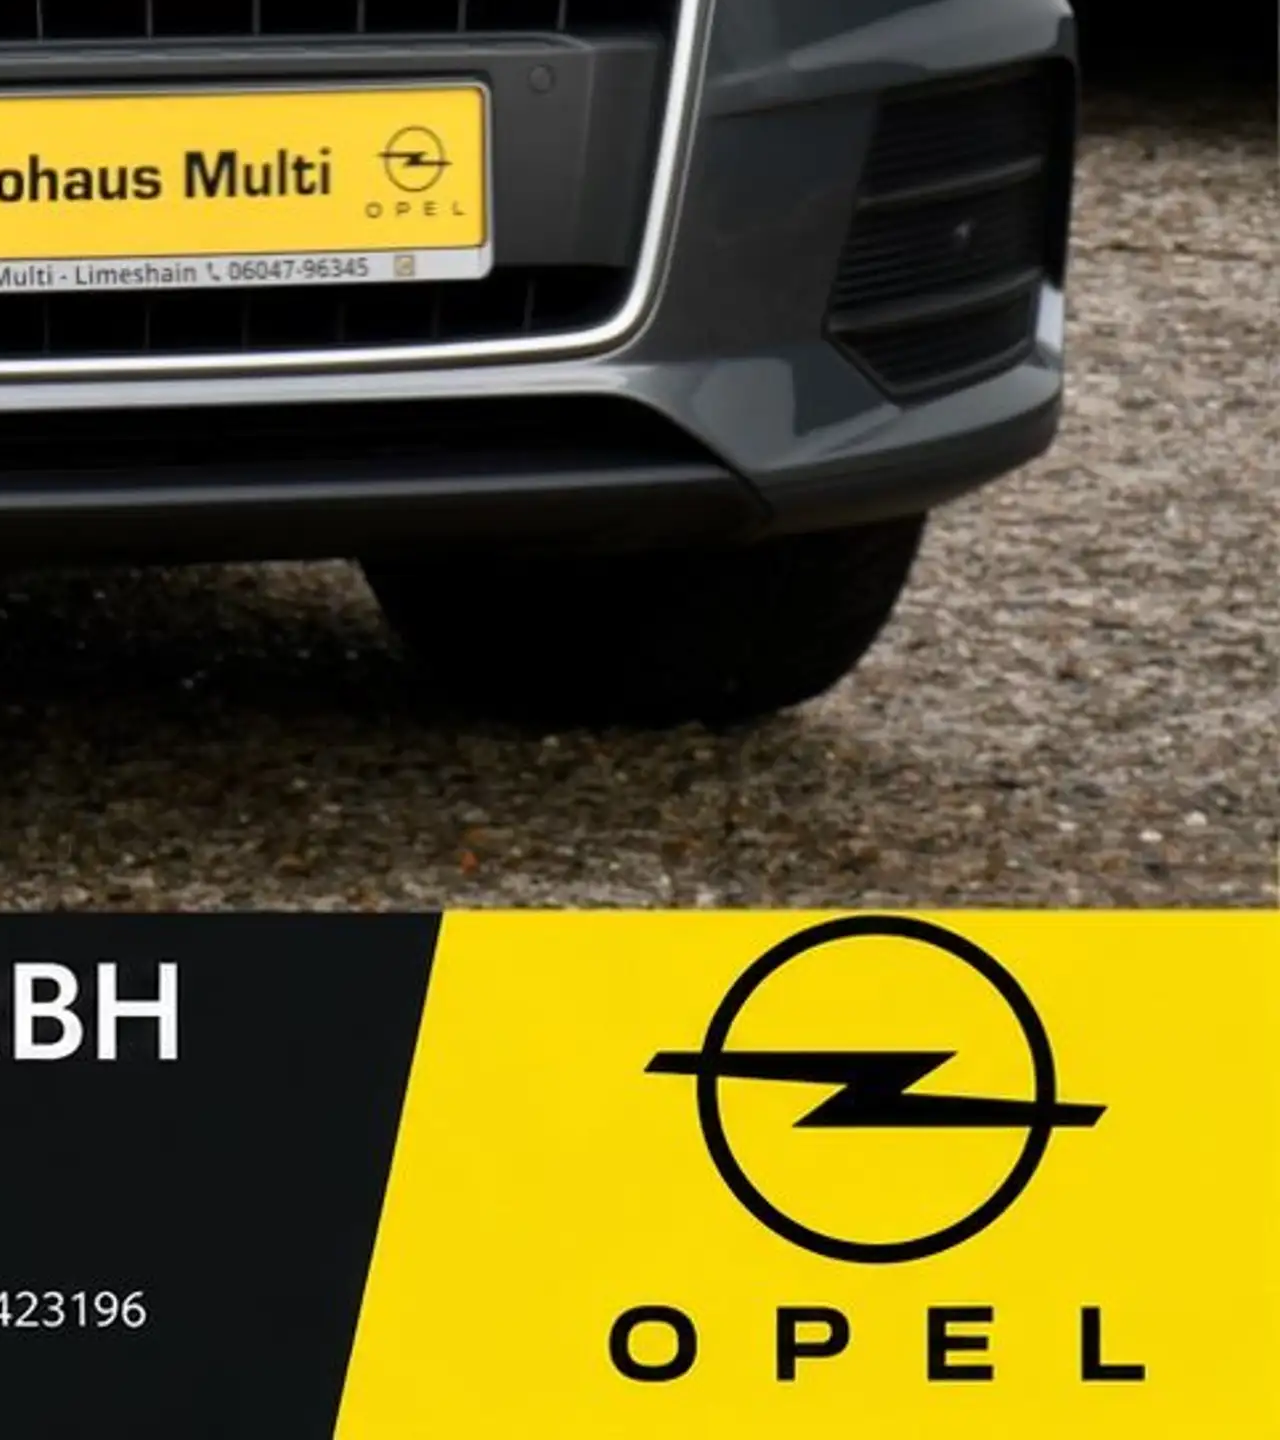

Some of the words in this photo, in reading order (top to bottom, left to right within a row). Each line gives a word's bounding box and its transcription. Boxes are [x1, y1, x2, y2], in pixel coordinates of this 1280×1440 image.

[184, 147, 331, 198] Multi
[365, 200, 466, 219] OPEL
[74, 262, 197, 286] Limeshain
[228, 257, 370, 281] 06047-96345
